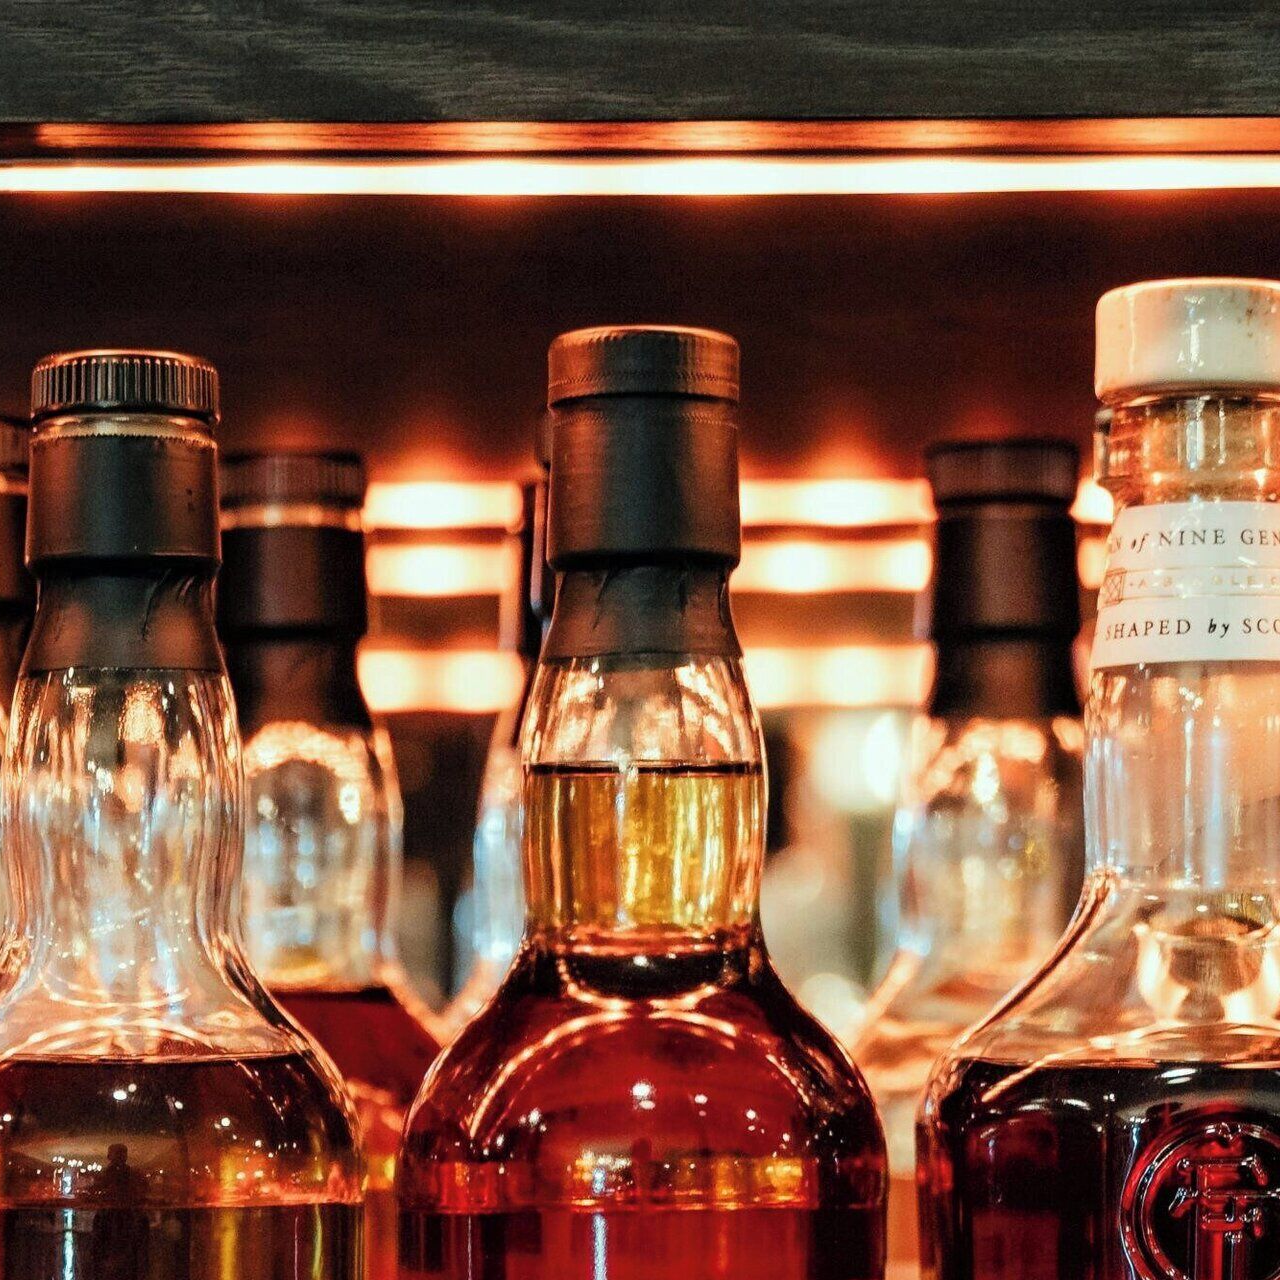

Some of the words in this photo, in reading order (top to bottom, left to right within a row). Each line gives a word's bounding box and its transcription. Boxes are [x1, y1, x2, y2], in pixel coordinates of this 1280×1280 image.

[1158, 529, 1225, 545] NINE
[1105, 620, 1190, 641] SHAPED
[1208, 619, 1229, 638] by
